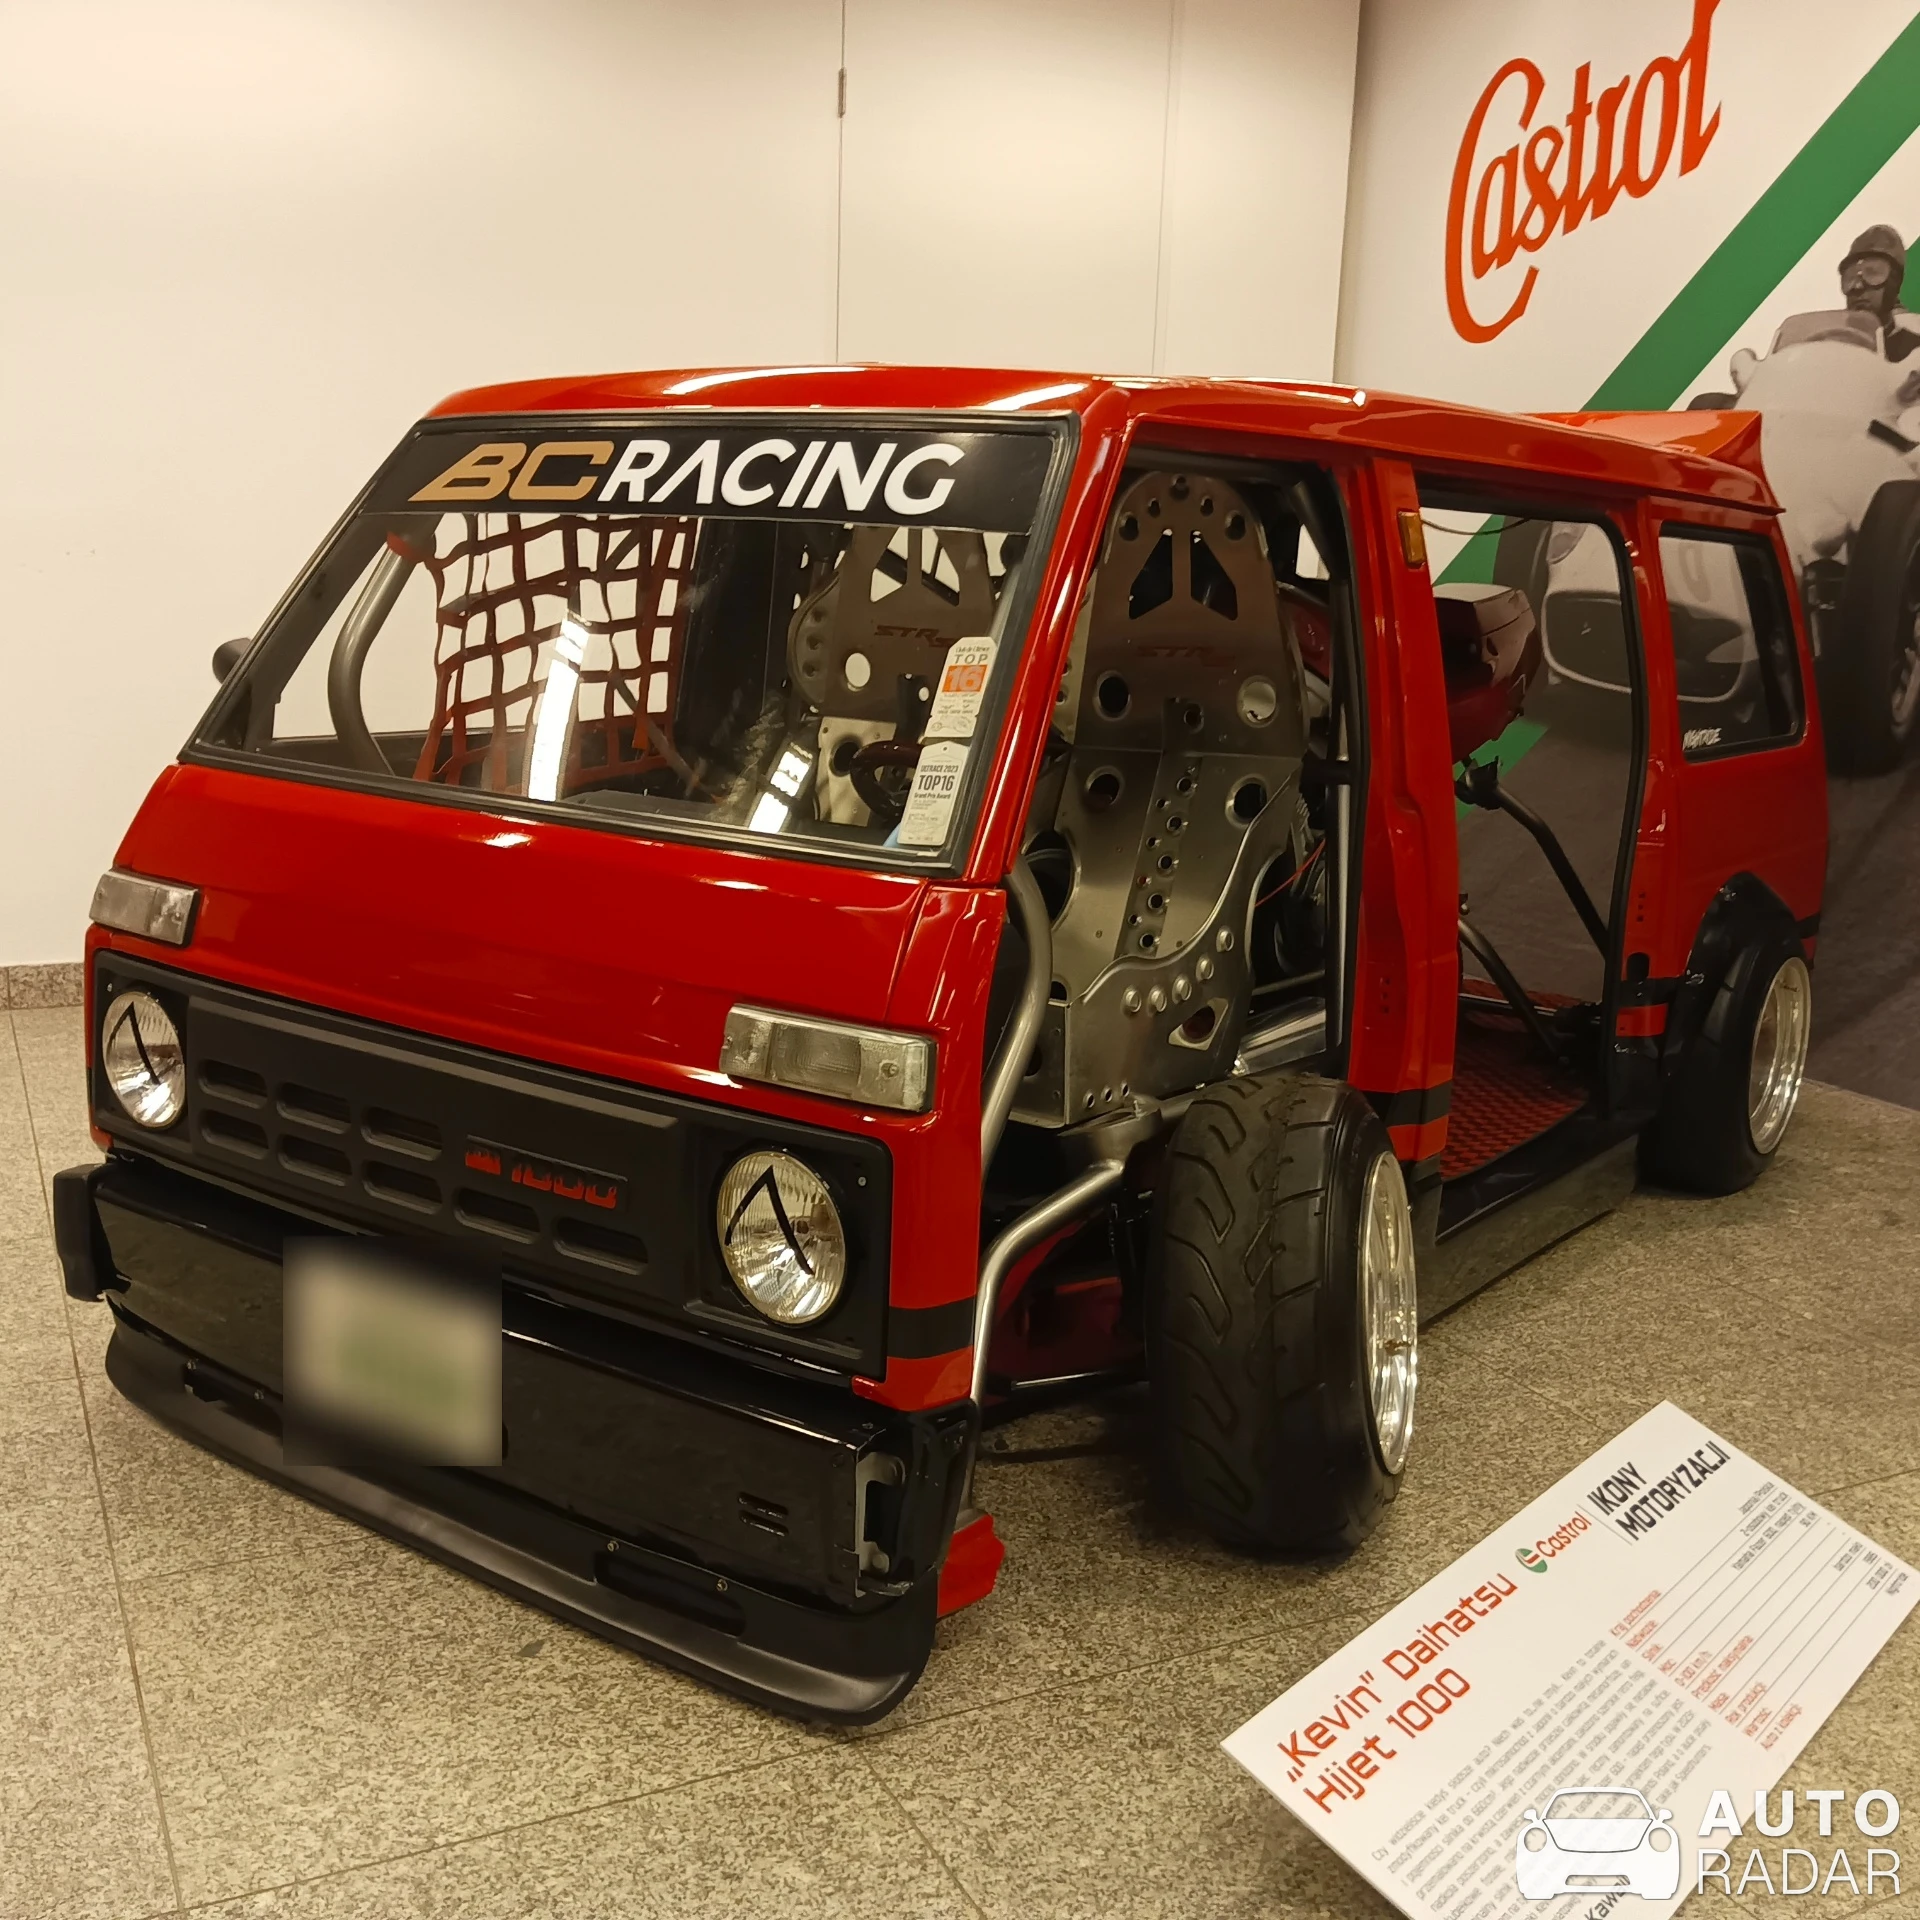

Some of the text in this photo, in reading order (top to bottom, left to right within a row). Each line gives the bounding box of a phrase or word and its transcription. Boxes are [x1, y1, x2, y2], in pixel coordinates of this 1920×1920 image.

[1446, 0, 1720, 343] Castrol
[948, 666, 982, 691] 16
[954, 654, 988, 665] TOP
[917, 775, 954, 791] TOP16
[1586, 1462, 1647, 1516] IKONY
[1615, 1440, 1731, 1541] MOTORYZACJI
[1536, 1511, 1592, 1558] Castrol
[1382, 1573, 1518, 1682] Daihatsu
[1303, 1668, 1471, 1814] Hijet 1000
